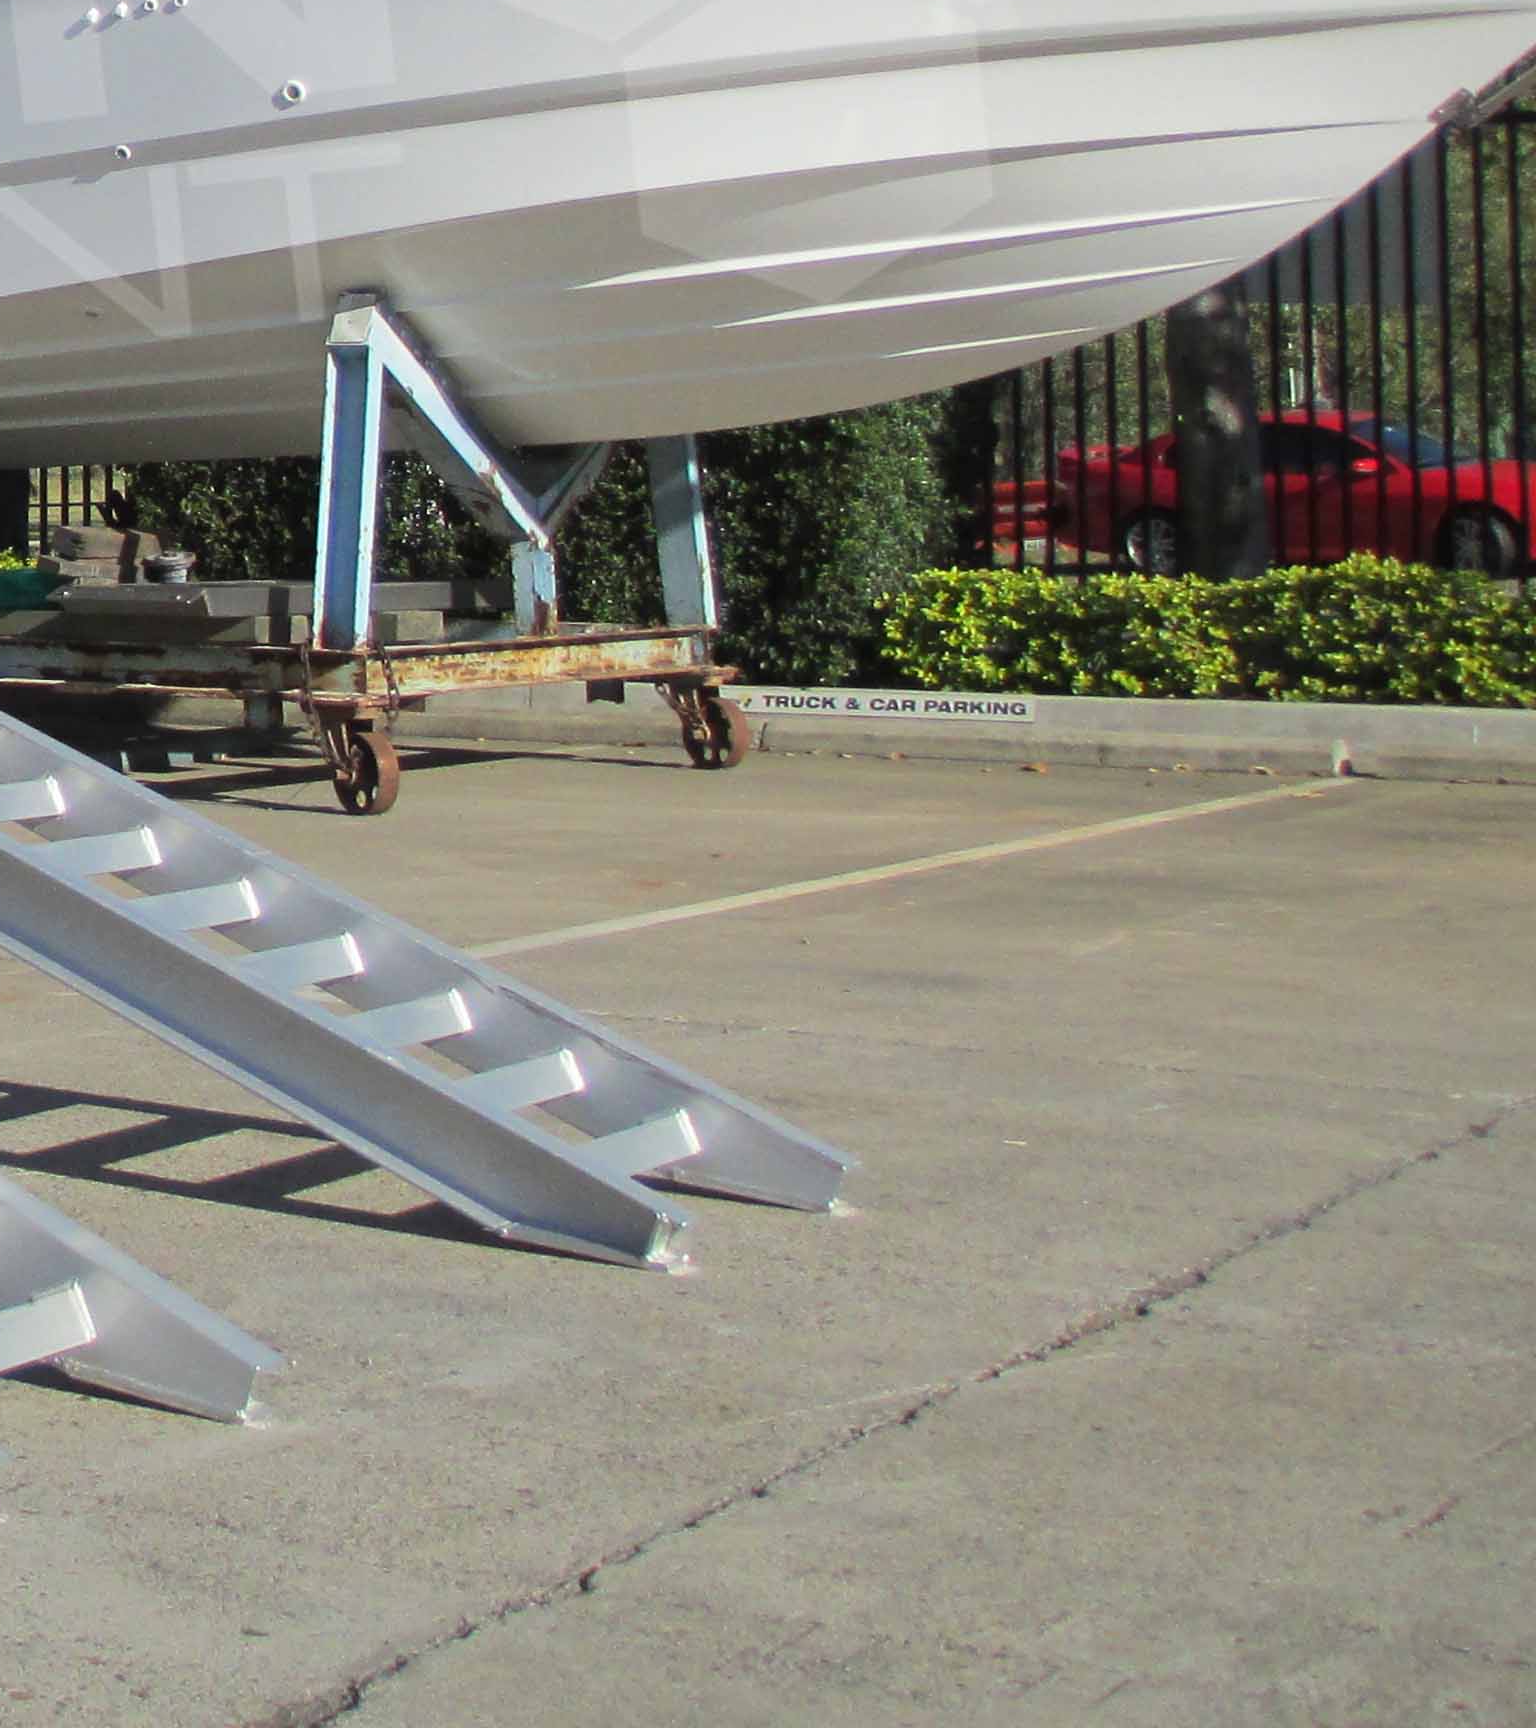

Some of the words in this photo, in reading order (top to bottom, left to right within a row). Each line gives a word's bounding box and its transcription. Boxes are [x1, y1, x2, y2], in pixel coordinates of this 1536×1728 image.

[762, 694, 837, 711] TRUCK
[844, 697, 862, 711] &
[869, 697, 917, 713] CAR
[923, 698, 1028, 717] PARKING
